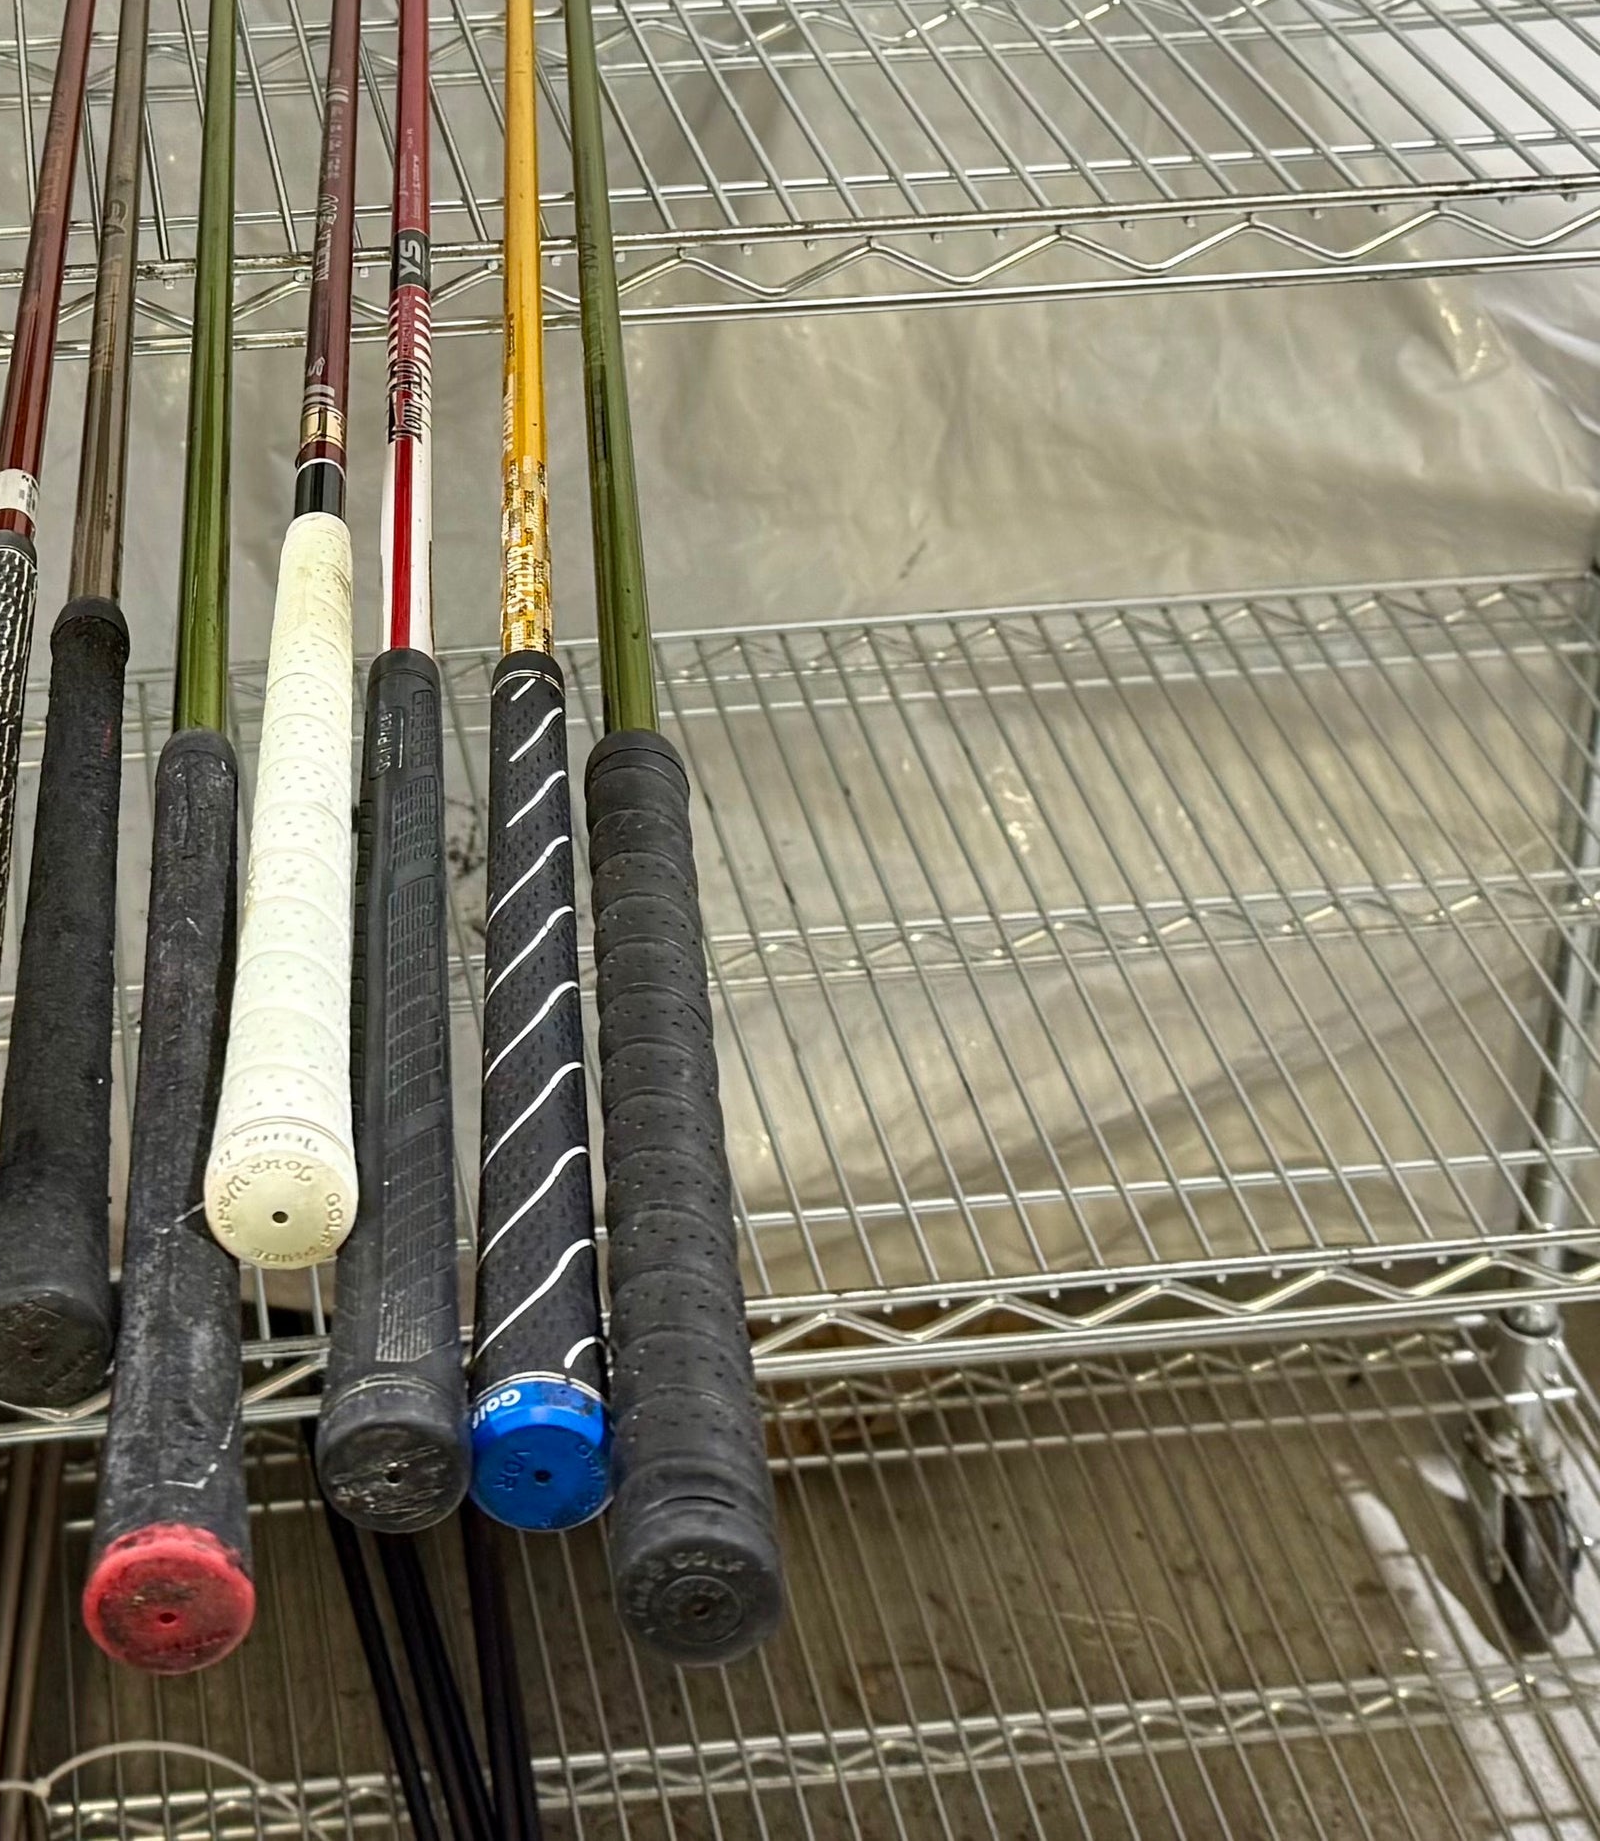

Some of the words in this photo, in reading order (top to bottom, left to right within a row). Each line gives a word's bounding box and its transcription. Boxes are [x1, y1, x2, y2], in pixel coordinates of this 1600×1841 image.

[399, 239, 421, 275] YS
[319, 1191, 344, 1248] GOLF
[499, 1448, 532, 1491] VDR
